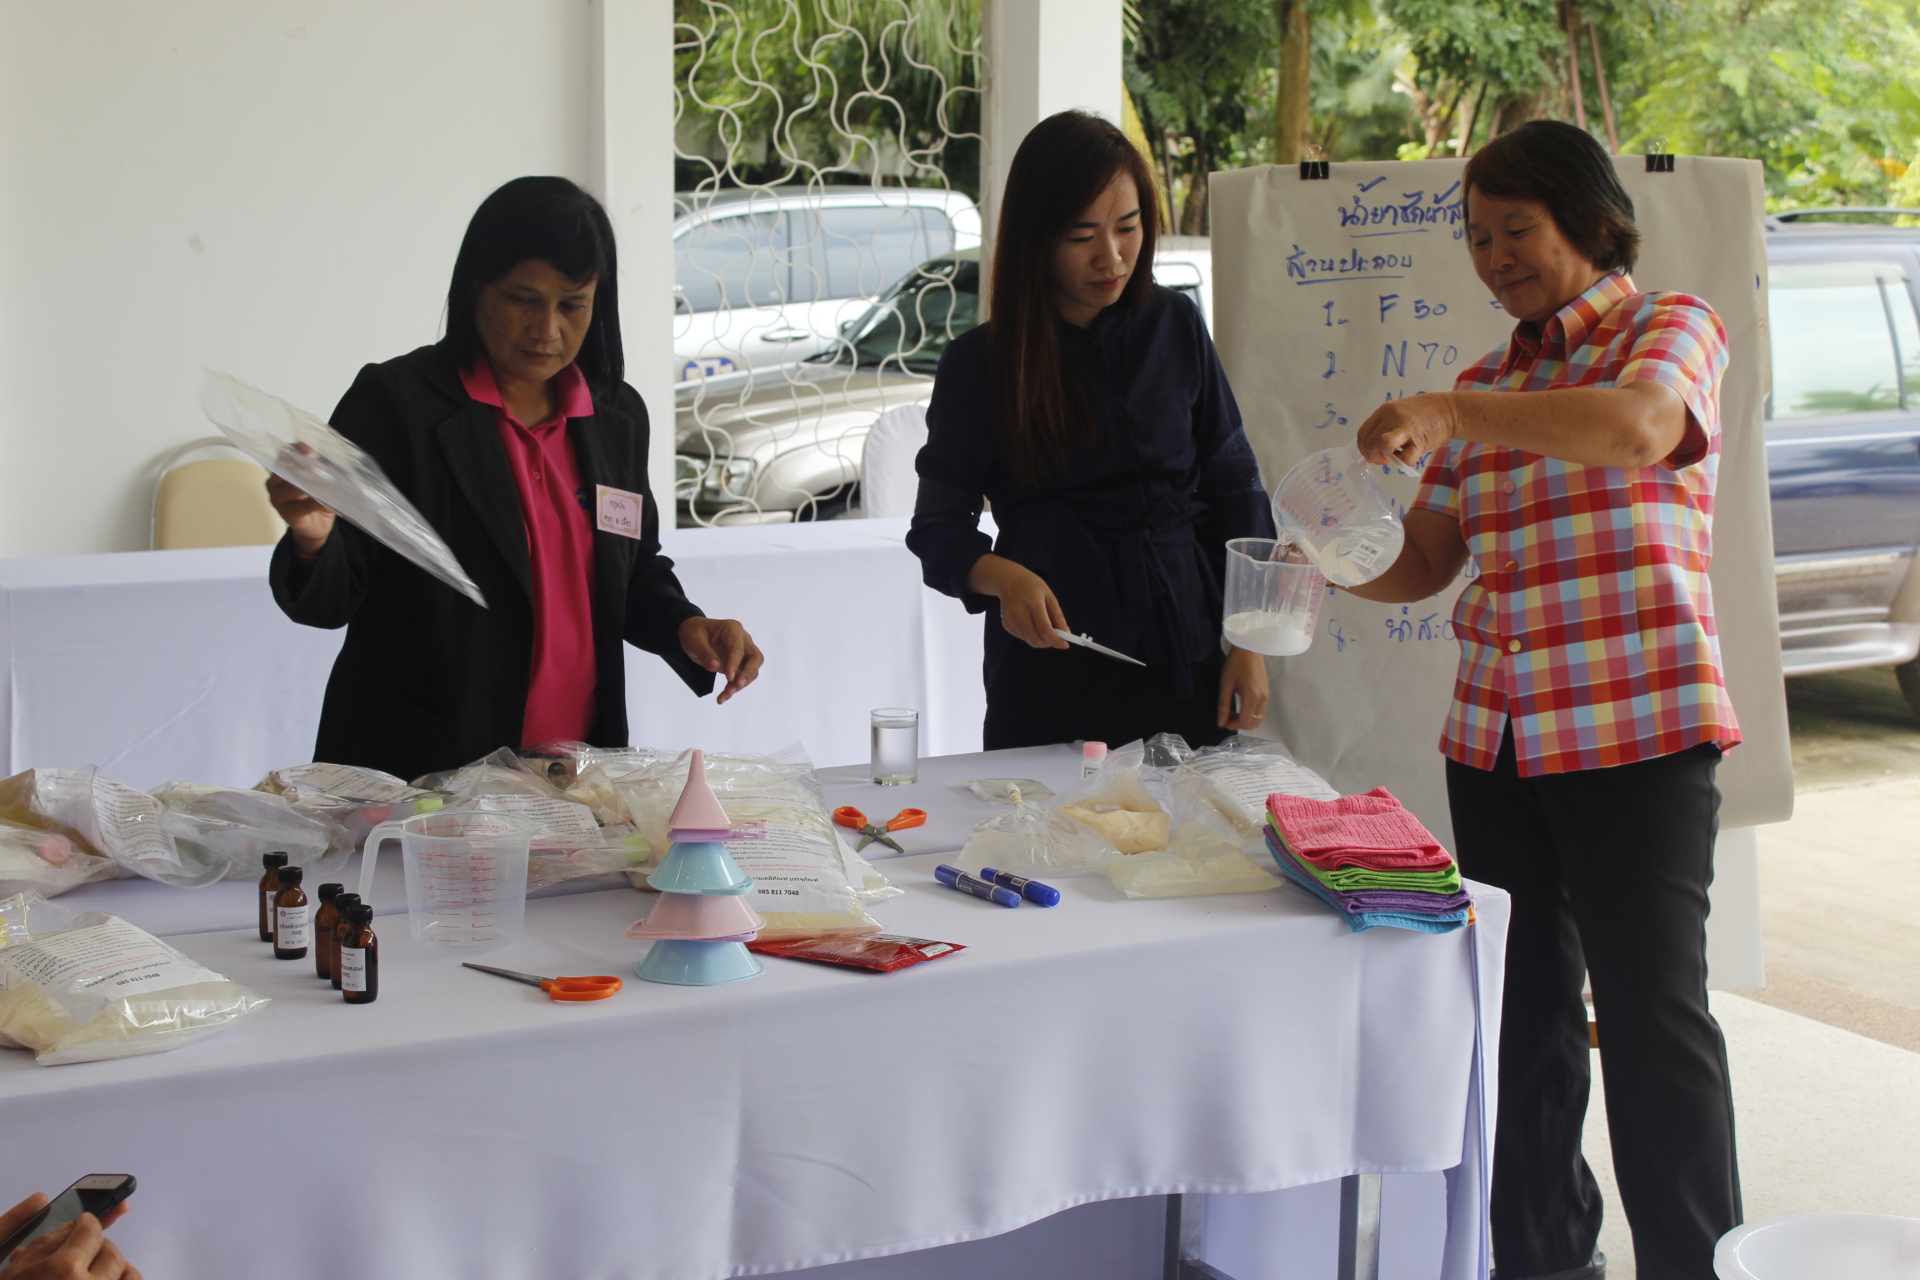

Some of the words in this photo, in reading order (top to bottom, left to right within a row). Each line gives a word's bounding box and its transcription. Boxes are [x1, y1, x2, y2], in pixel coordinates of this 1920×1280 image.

[1379, 293, 1400, 324] F
[1414, 299, 1448, 320] 50
[1382, 340, 1408, 378] N
[1418, 342, 1458, 369] 70
